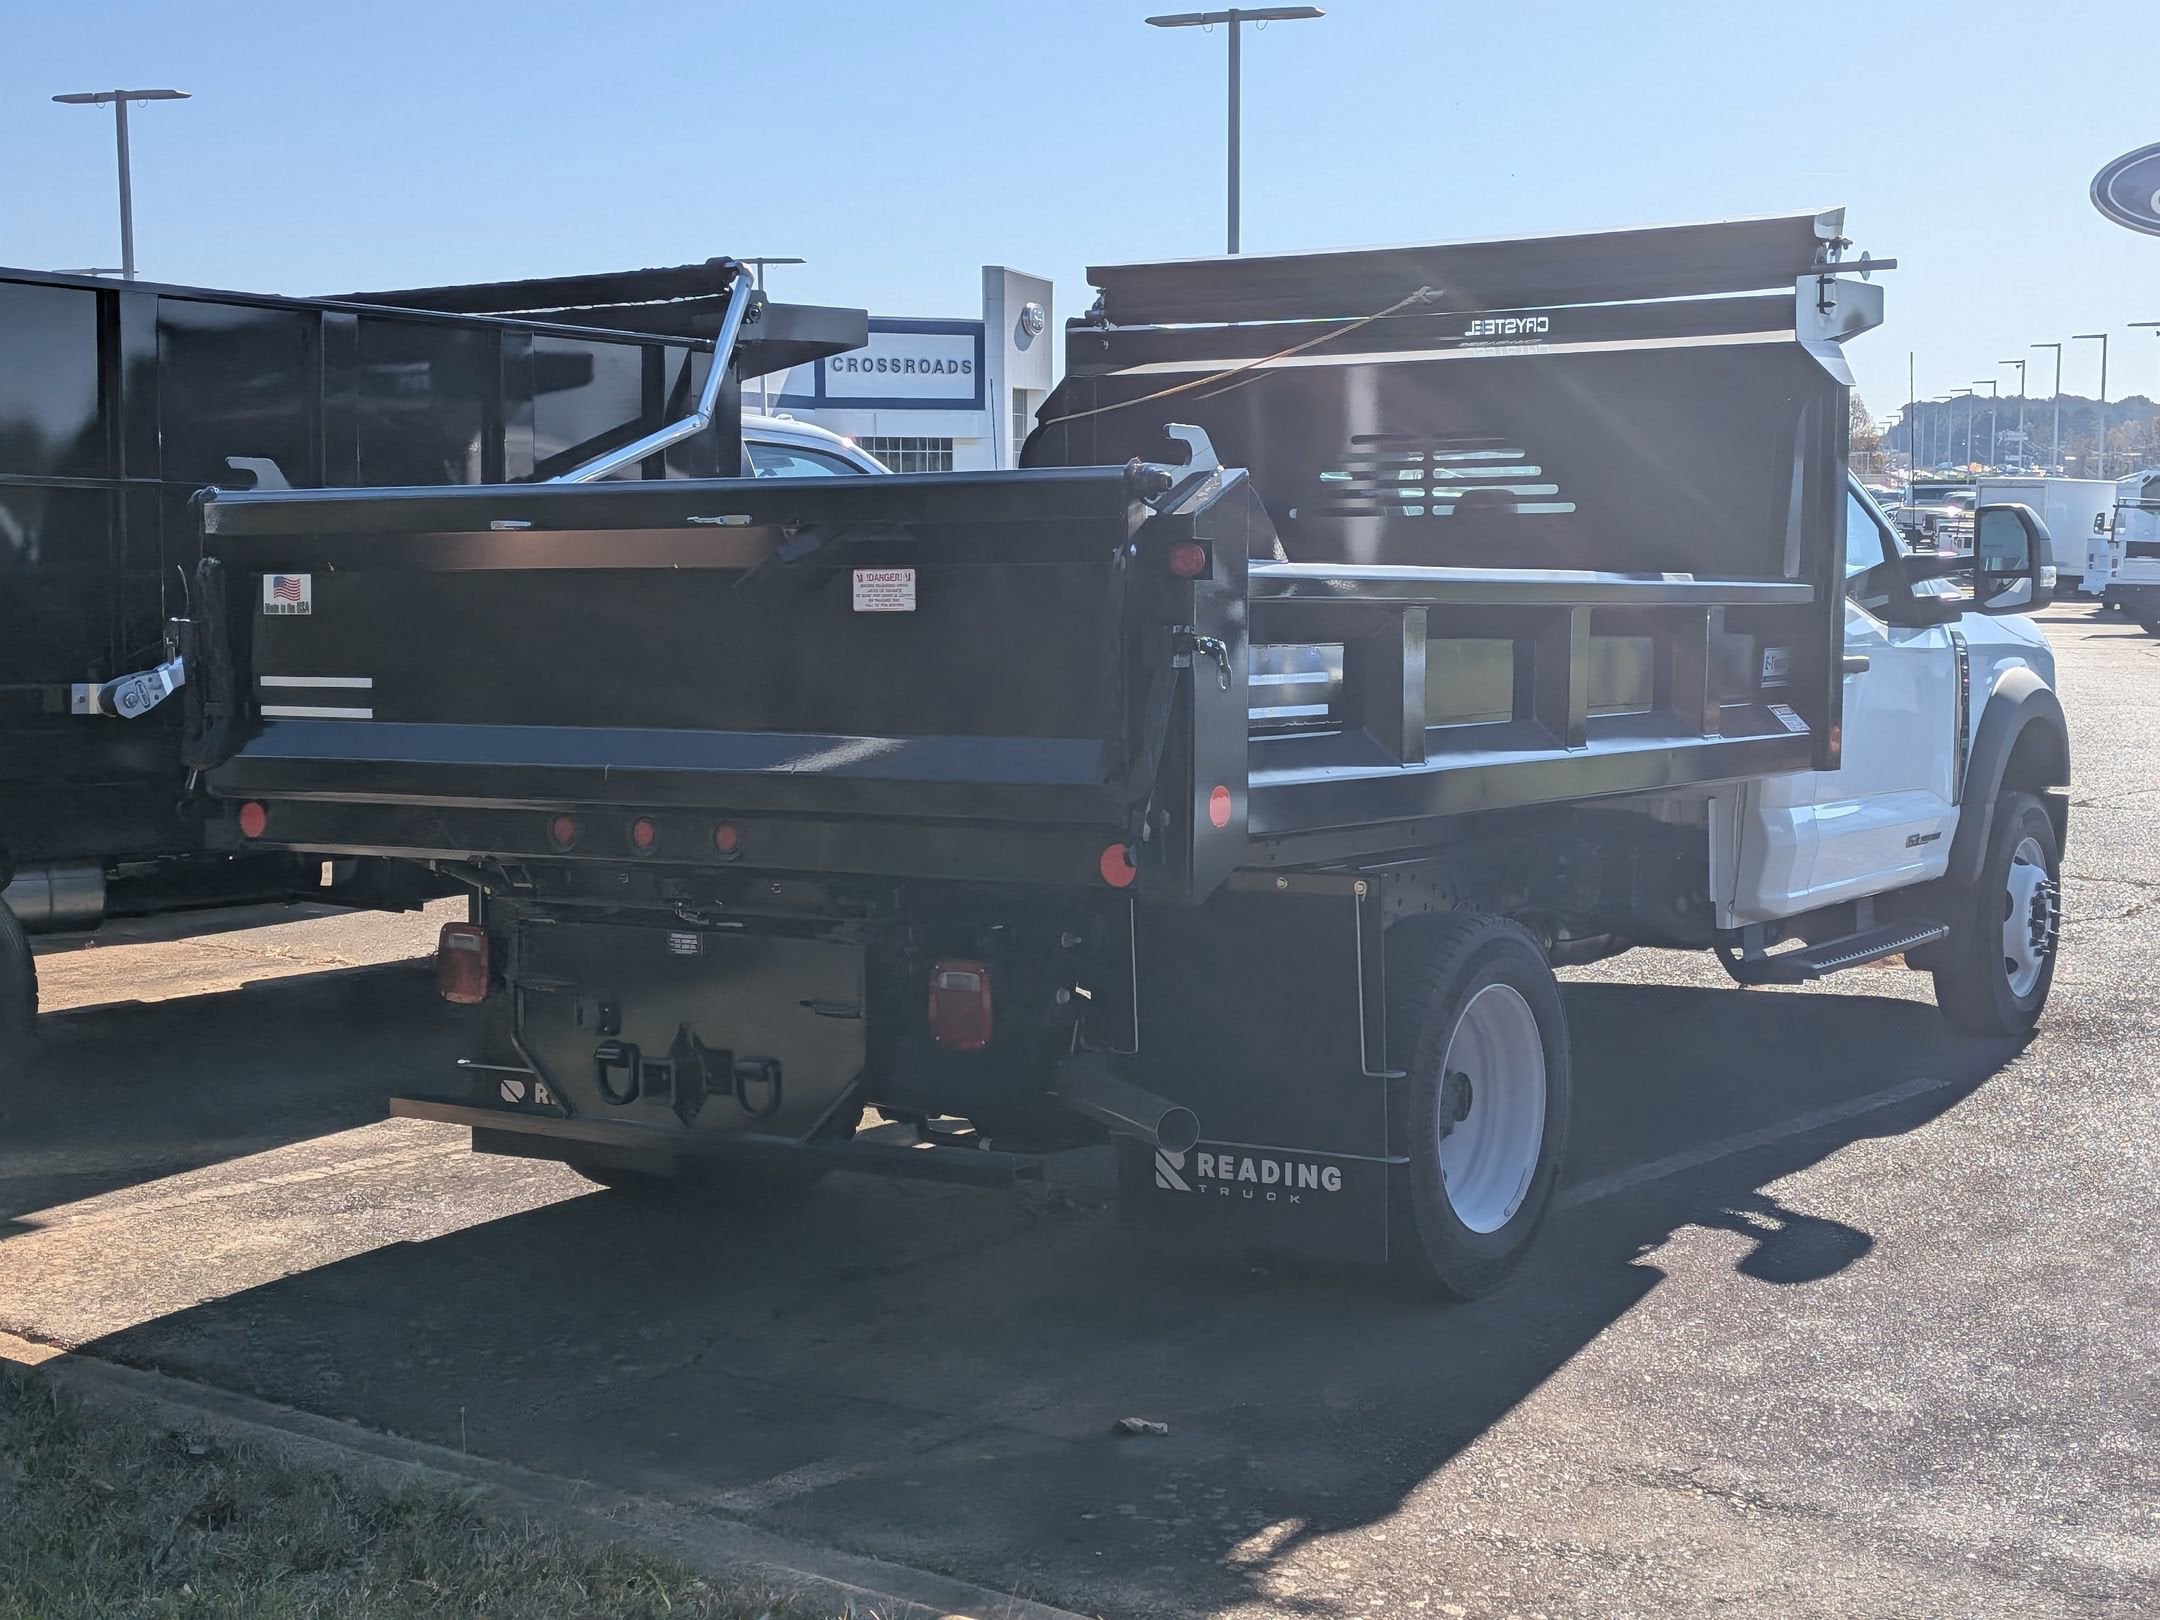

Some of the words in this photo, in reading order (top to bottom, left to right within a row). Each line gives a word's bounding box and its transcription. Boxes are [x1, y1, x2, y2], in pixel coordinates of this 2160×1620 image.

[832, 357, 972, 374] CROSSROADS
[1198, 1152, 1342, 1192] READING
[1198, 1184, 1301, 1204] TRUCK
